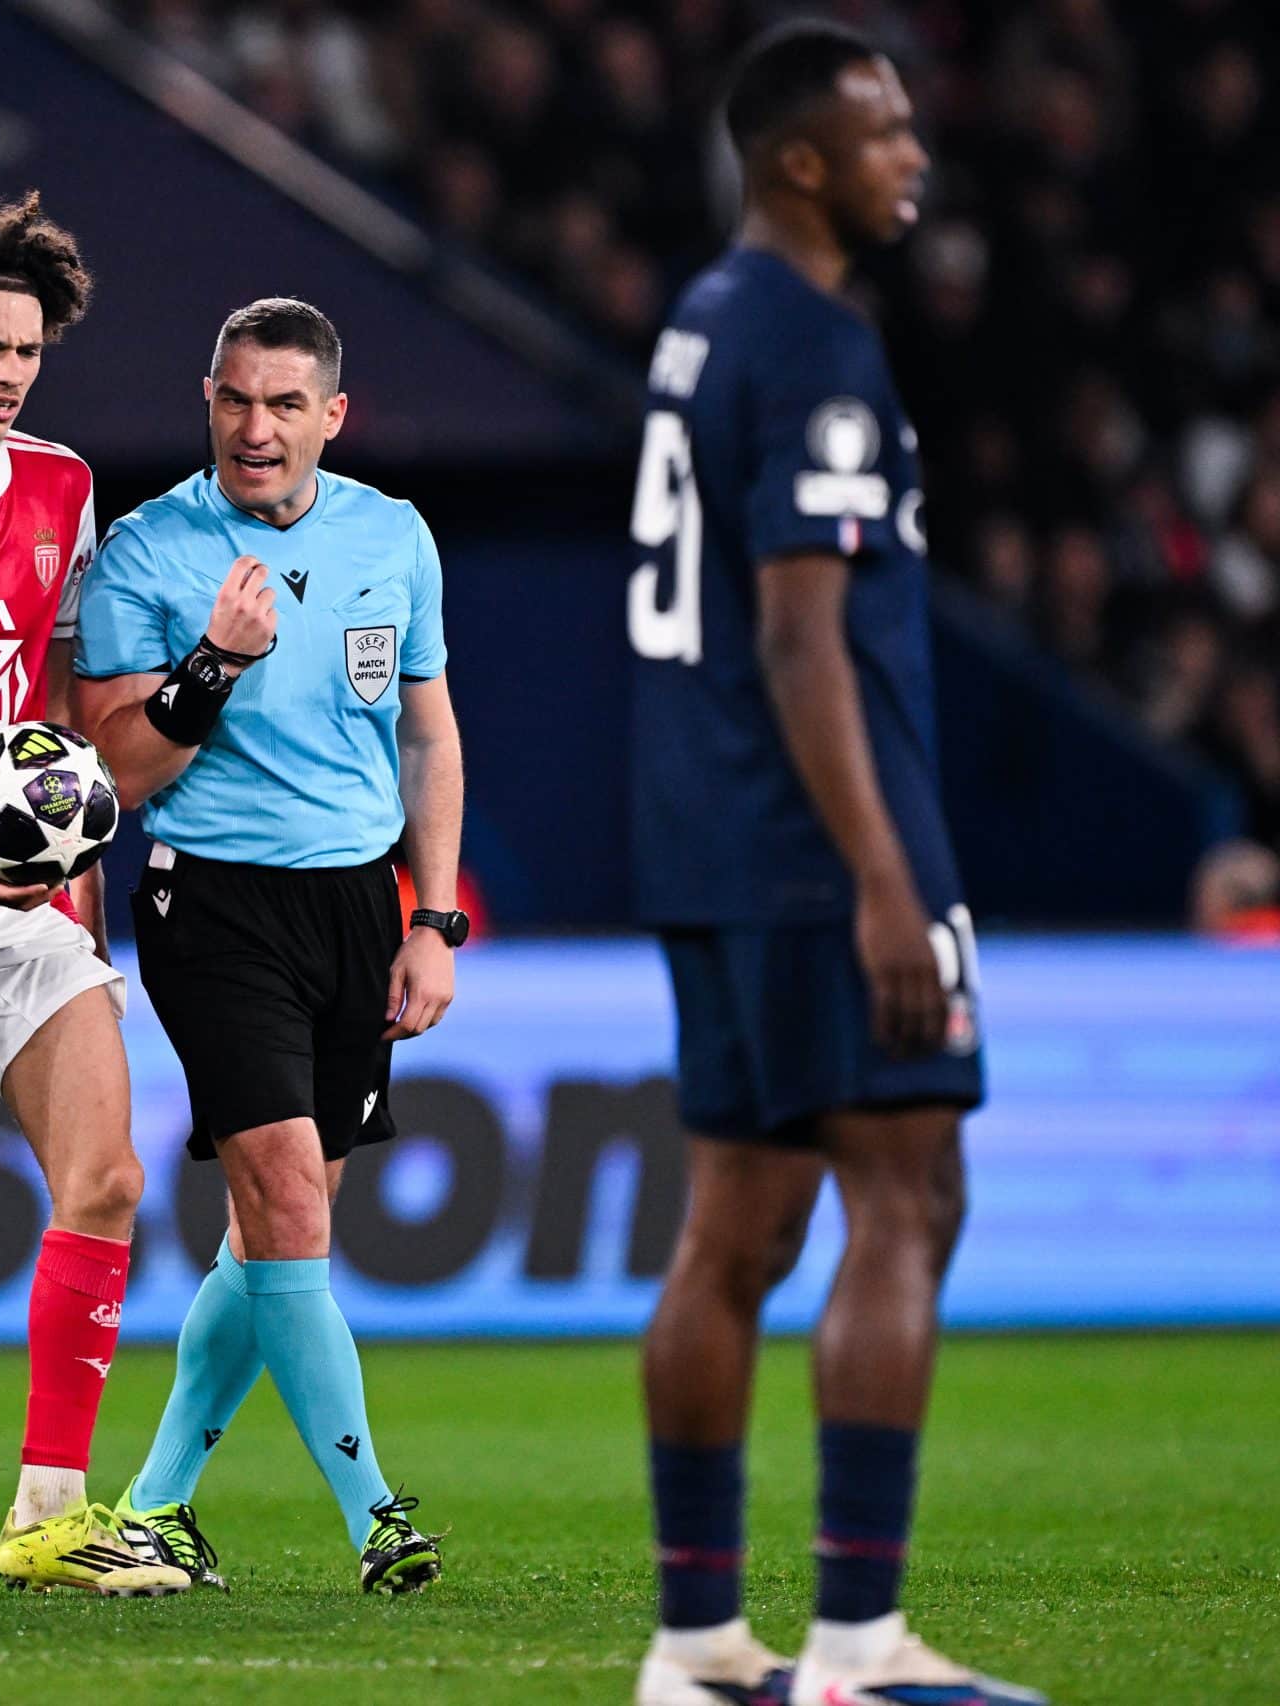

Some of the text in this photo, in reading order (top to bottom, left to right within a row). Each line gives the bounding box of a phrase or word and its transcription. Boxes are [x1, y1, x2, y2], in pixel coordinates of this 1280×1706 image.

[357, 637, 385, 651] UEFA
[357, 659, 385, 669] MATCH
[354, 670, 388, 681] OFFICIAL
